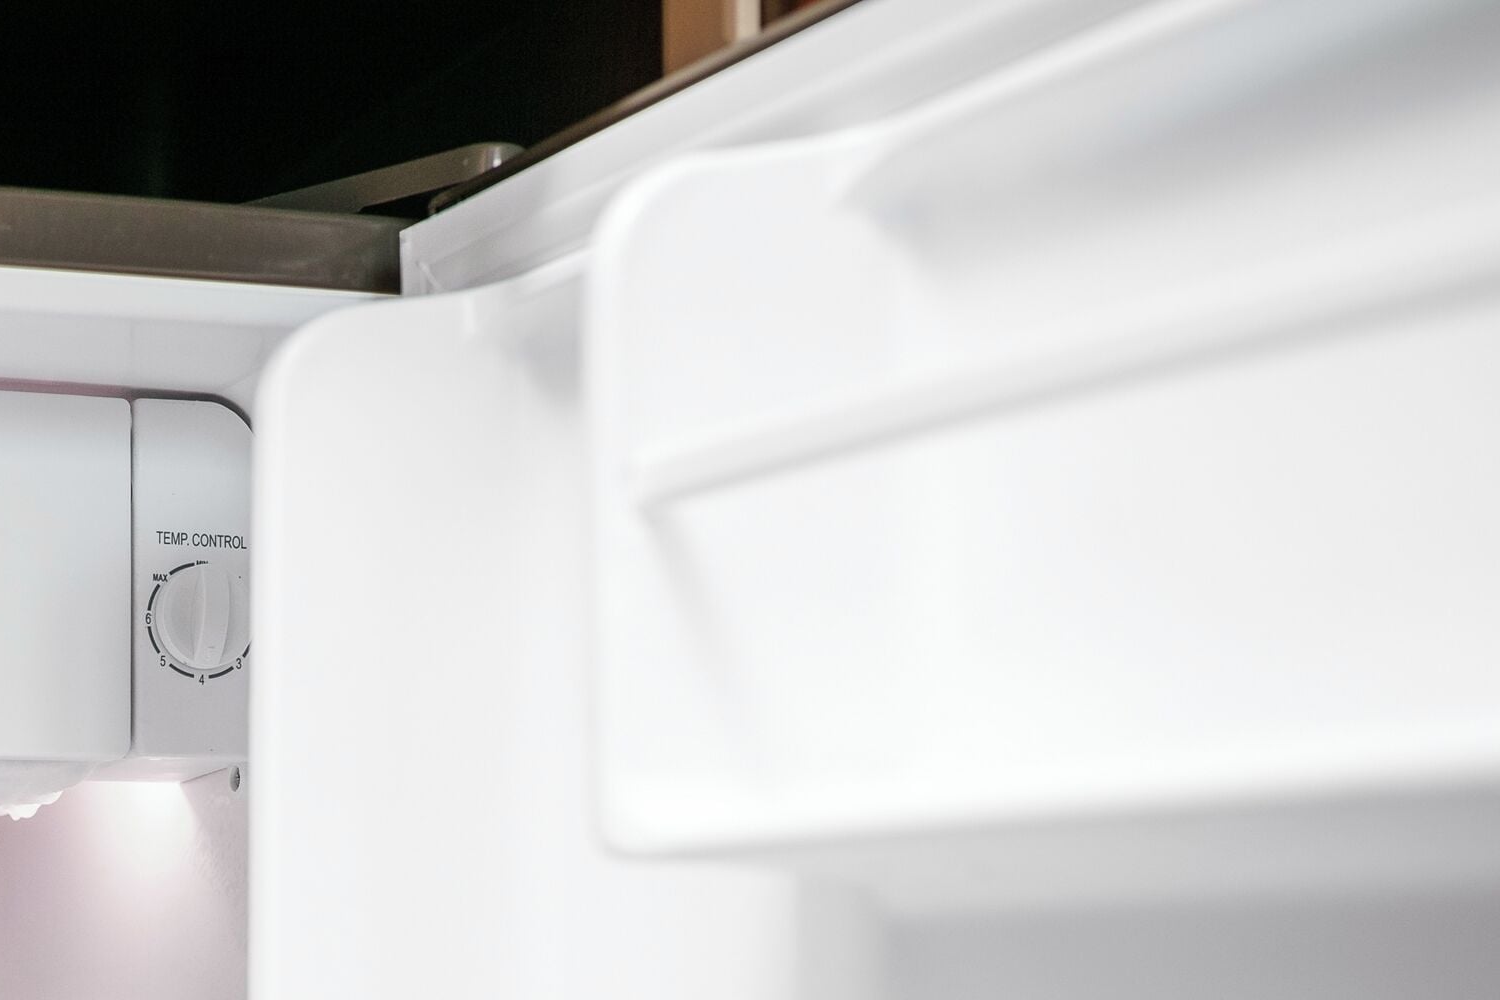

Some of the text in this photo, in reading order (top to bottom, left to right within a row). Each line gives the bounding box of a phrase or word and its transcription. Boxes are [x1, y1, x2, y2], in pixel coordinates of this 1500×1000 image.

[156, 531, 247, 550] TEMP. CONTROL
[152, 573, 168, 583] MAX
[145, 613, 152, 625] 6
[160, 655, 166, 667] 5
[235, 658, 242, 670] 3
[198, 674, 205, 686] 4
